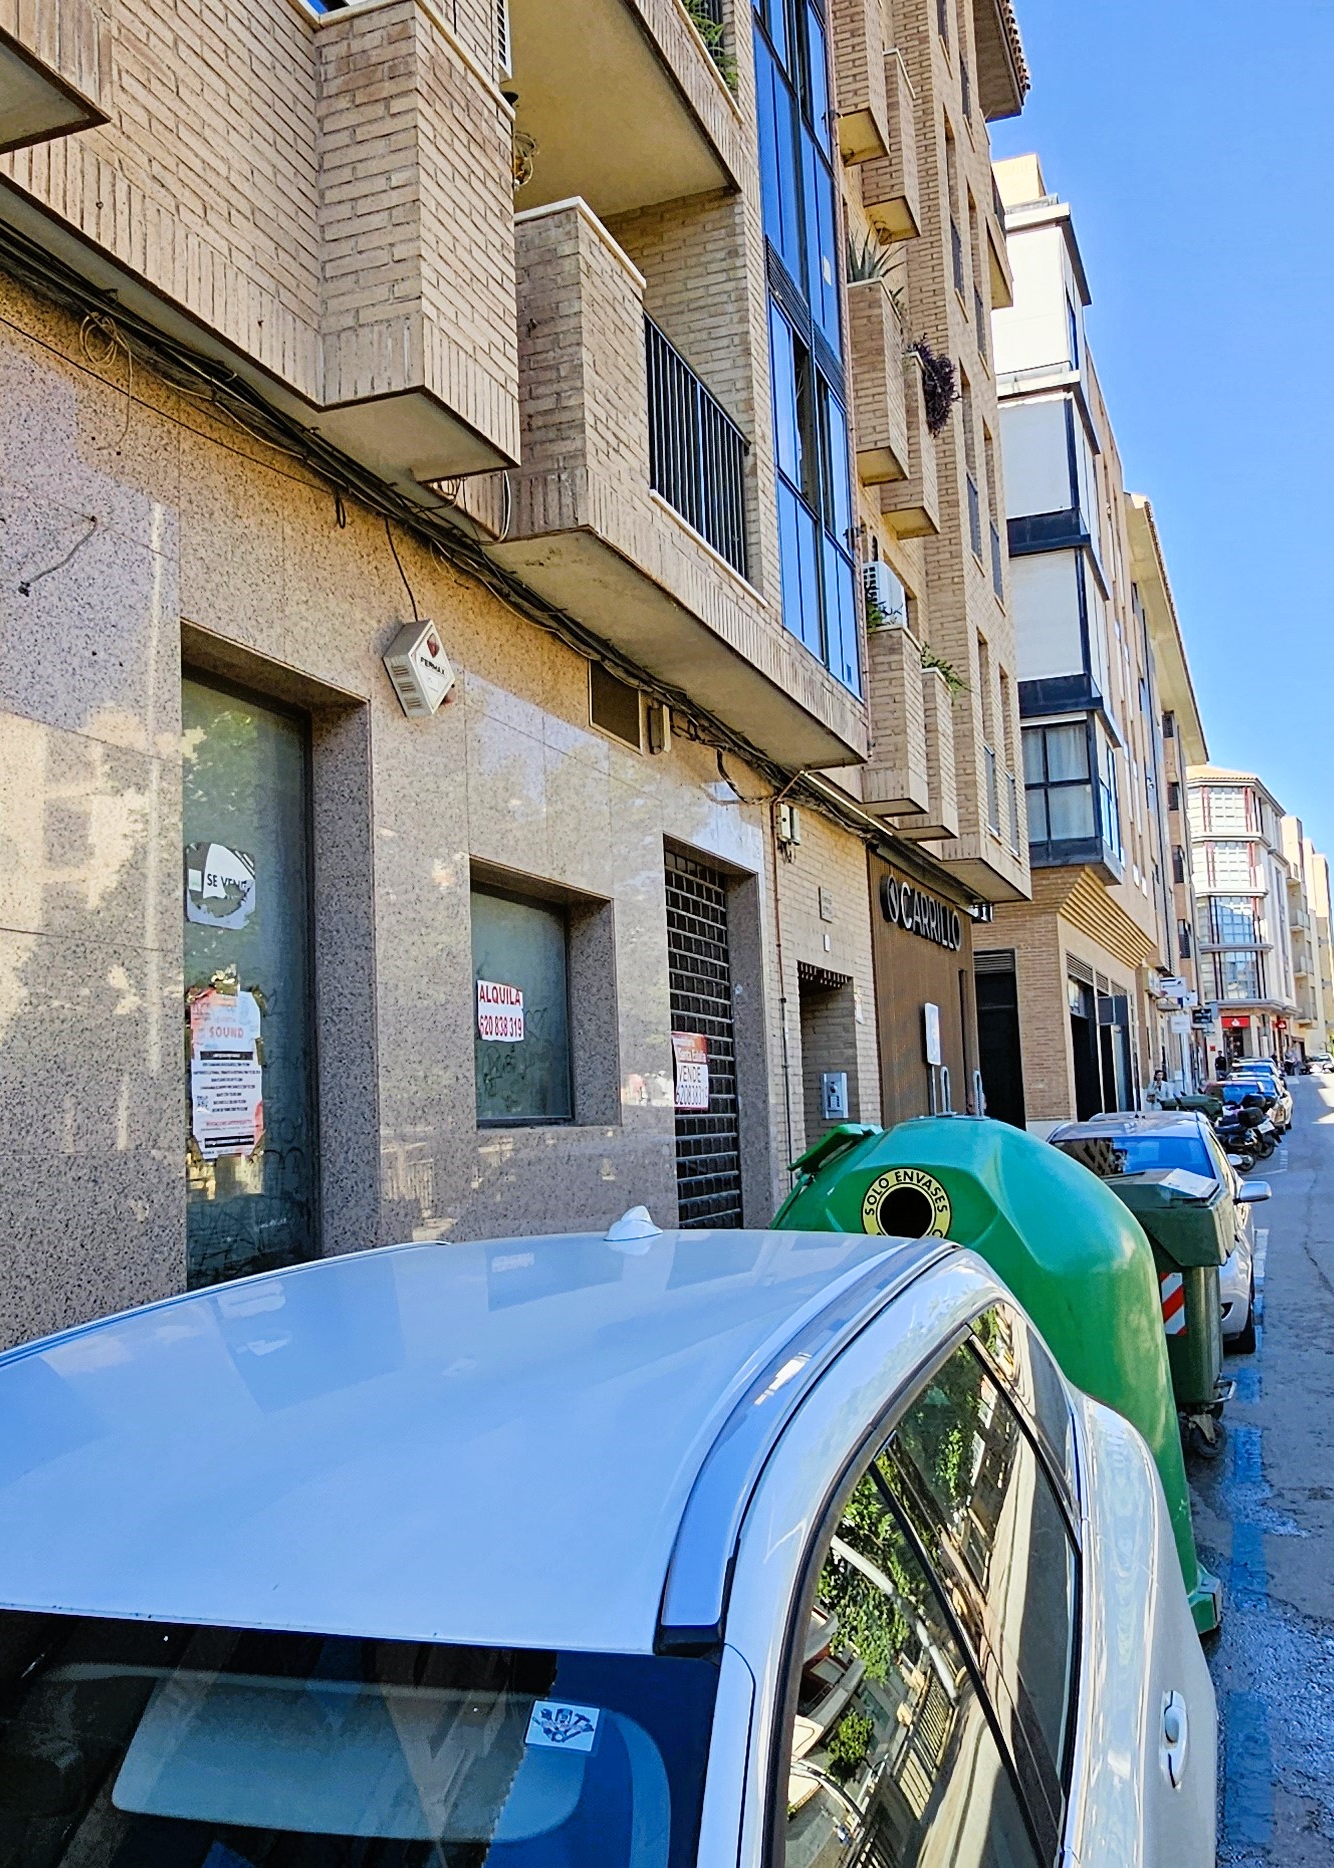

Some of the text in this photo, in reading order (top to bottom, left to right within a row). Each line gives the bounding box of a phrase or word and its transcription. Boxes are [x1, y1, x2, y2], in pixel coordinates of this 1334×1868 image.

[207, 873, 218, 888] SE
[900, 881, 962, 952] CARRILLO
[479, 984, 521, 1006] ALQUILA
[209, 1026, 244, 1039] SOUND
[865, 1170, 948, 1216] SOLO ENVASES
